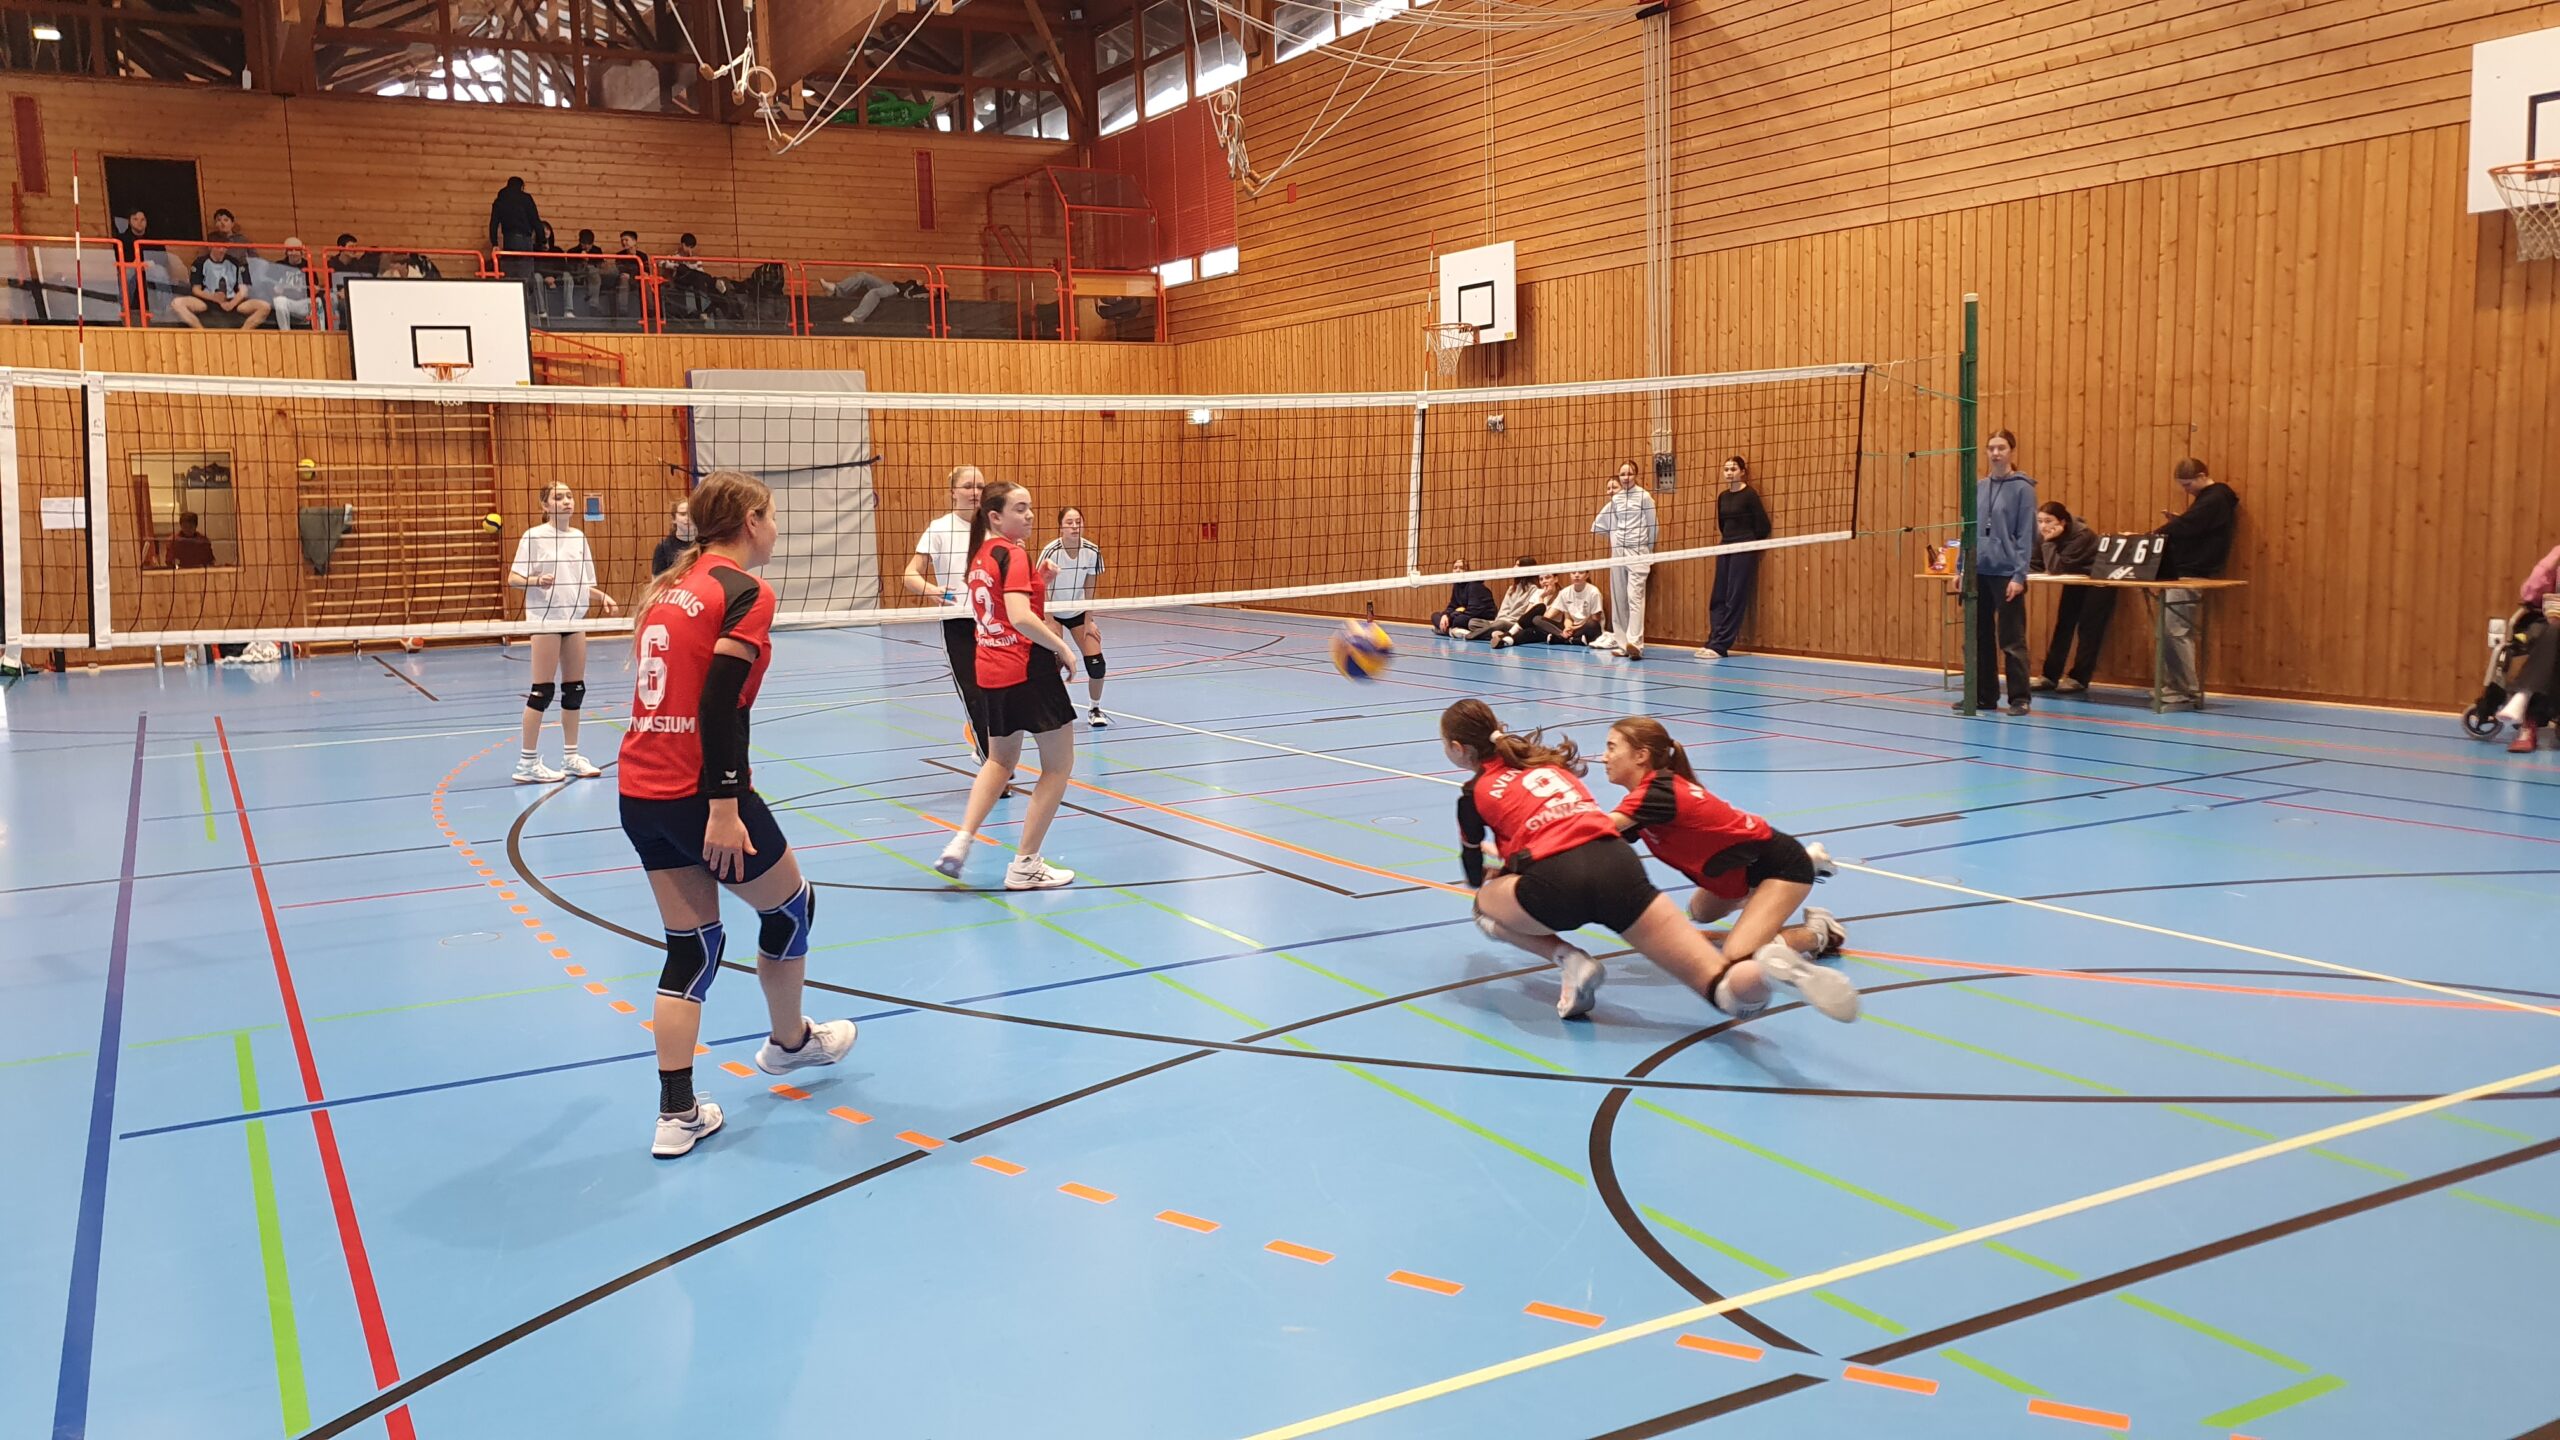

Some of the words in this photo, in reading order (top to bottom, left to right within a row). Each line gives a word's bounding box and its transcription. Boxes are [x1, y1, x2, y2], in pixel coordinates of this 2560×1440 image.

[2098, 537, 2110, 552] 0
[2110, 539, 2127, 562] 7
[2133, 540, 2149, 563] 6
[2153, 538, 2164, 553] 0
[638, 624, 670, 710] 6
[1522, 767, 1582, 808] 9
